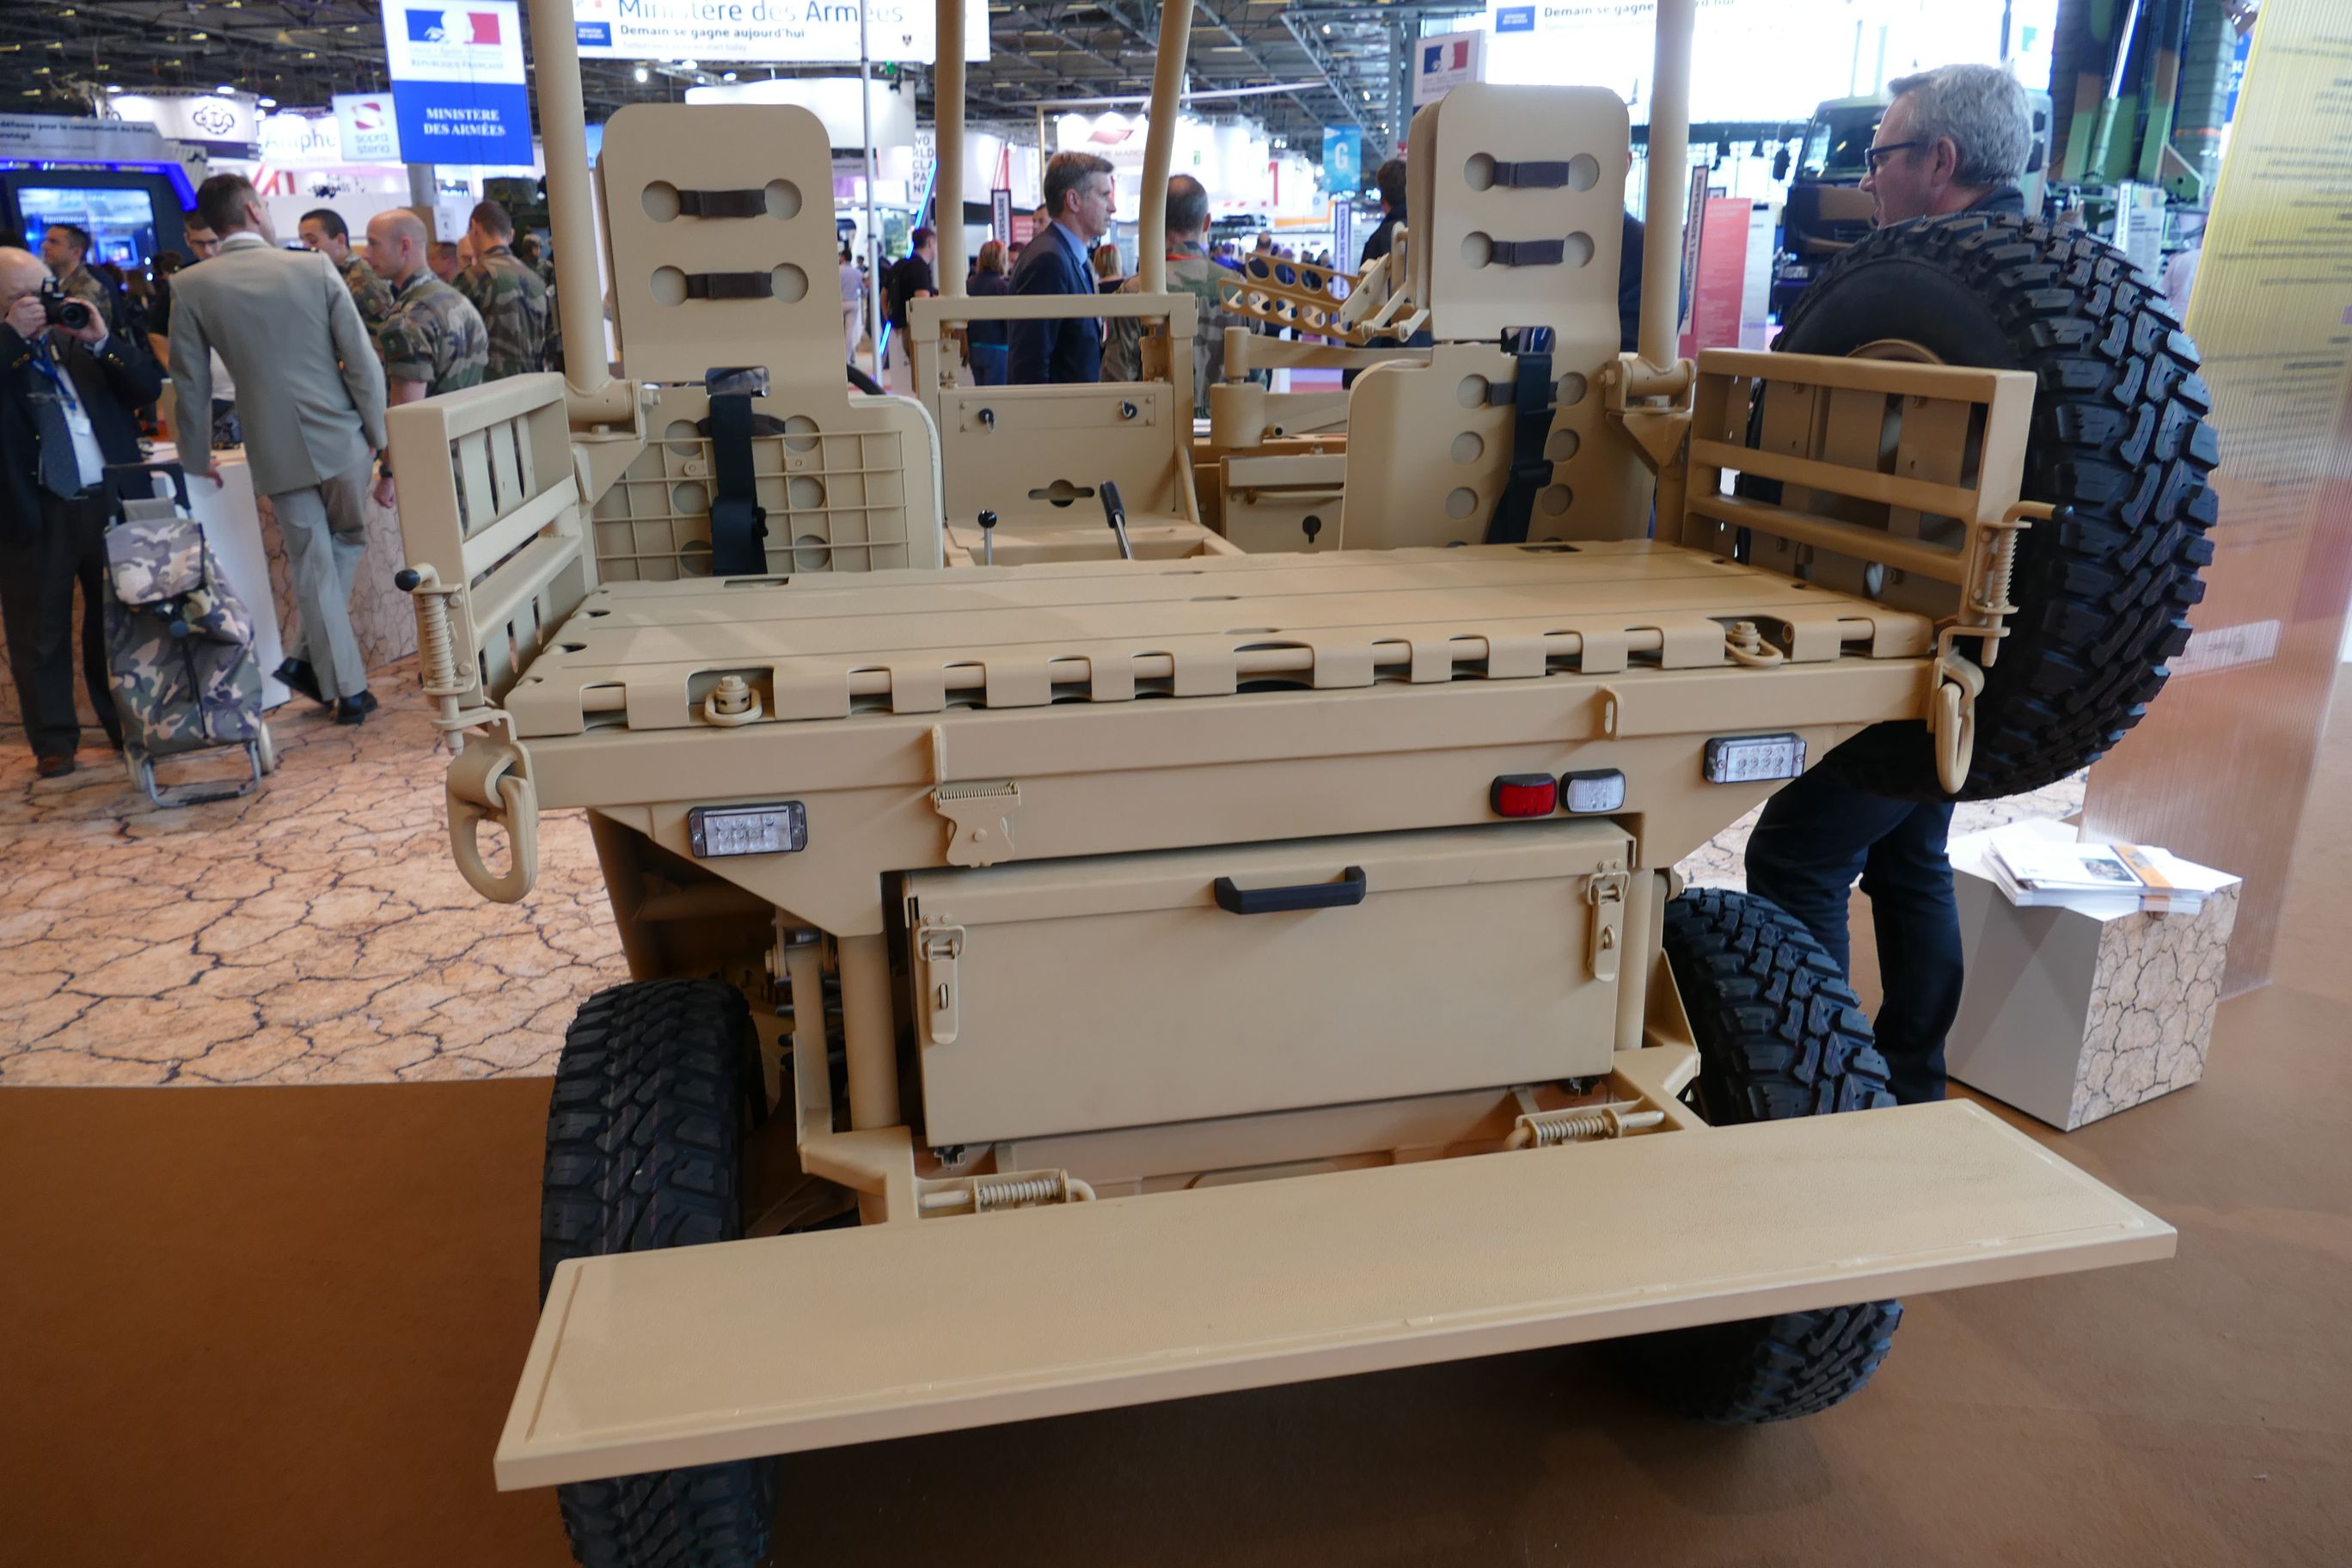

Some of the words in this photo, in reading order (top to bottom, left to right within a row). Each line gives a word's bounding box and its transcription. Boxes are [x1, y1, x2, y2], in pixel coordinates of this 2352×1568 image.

[619, 0, 742, 21] Mintère
[752, 0, 796, 21] des
[1544, 7, 1593, 18] Demain
[1614, 3, 1655, 16] gagne
[620, 24, 670, 36] Demain
[690, 28, 730, 40] gagne
[733, 28, 805, 40] aujourd'hui
[423, 122, 450, 136] DES
[451, 122, 506, 137] ARMÉES
[355, 133, 389, 145] sopra
[357, 144, 390, 155] steria
